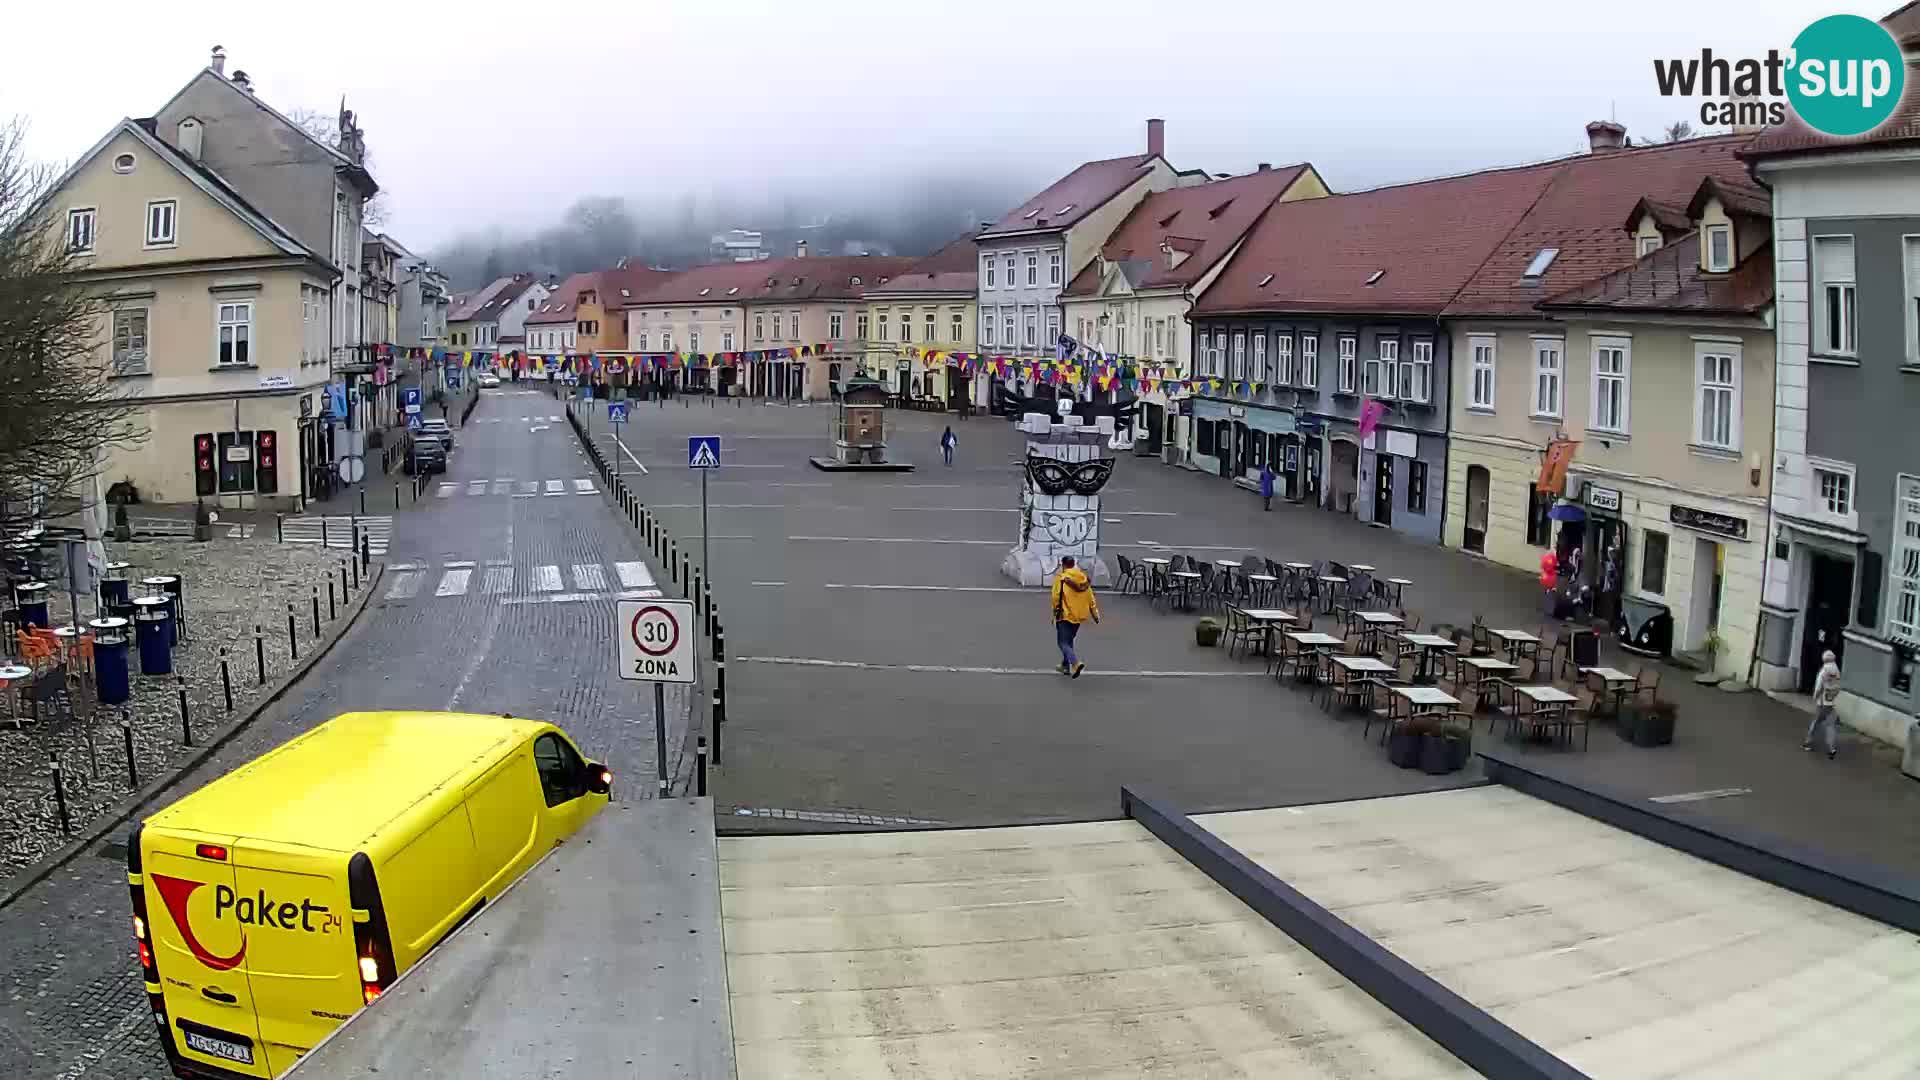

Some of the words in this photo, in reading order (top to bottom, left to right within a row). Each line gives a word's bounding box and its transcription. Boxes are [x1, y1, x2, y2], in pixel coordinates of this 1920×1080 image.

[408, 391, 416, 403] P
[644, 622, 668, 643] 30
[634, 659, 679, 675] ZONA
[215, 884, 329, 932] Paket
